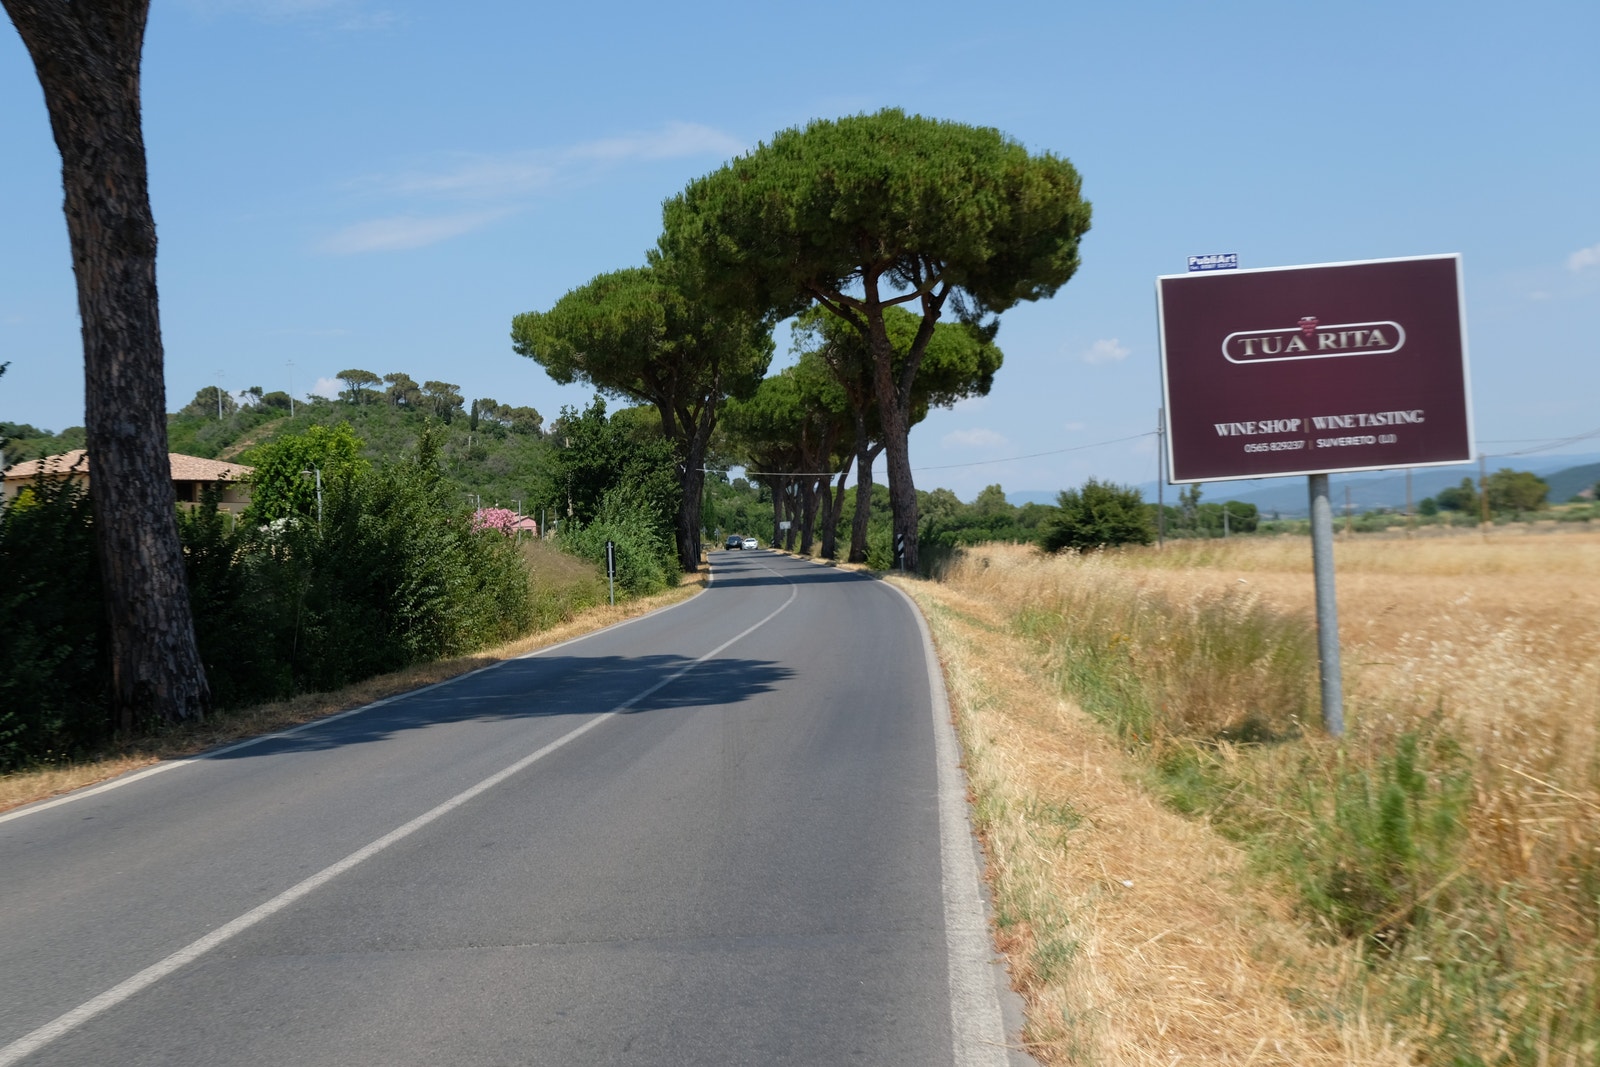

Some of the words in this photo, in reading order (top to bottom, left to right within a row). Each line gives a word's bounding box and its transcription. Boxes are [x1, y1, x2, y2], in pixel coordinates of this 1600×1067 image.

[1238, 335, 1309, 356] TUA
[1317, 329, 1390, 350] RITA
[1214, 421, 1258, 436] WINE
[1258, 418, 1302, 434] SHOP
[1312, 414, 1356, 429] WINE
[1356, 410, 1425, 427] TASTING
[1243, 442, 1270, 453] 0565
[1316, 435, 1377, 448] SUVERETO
